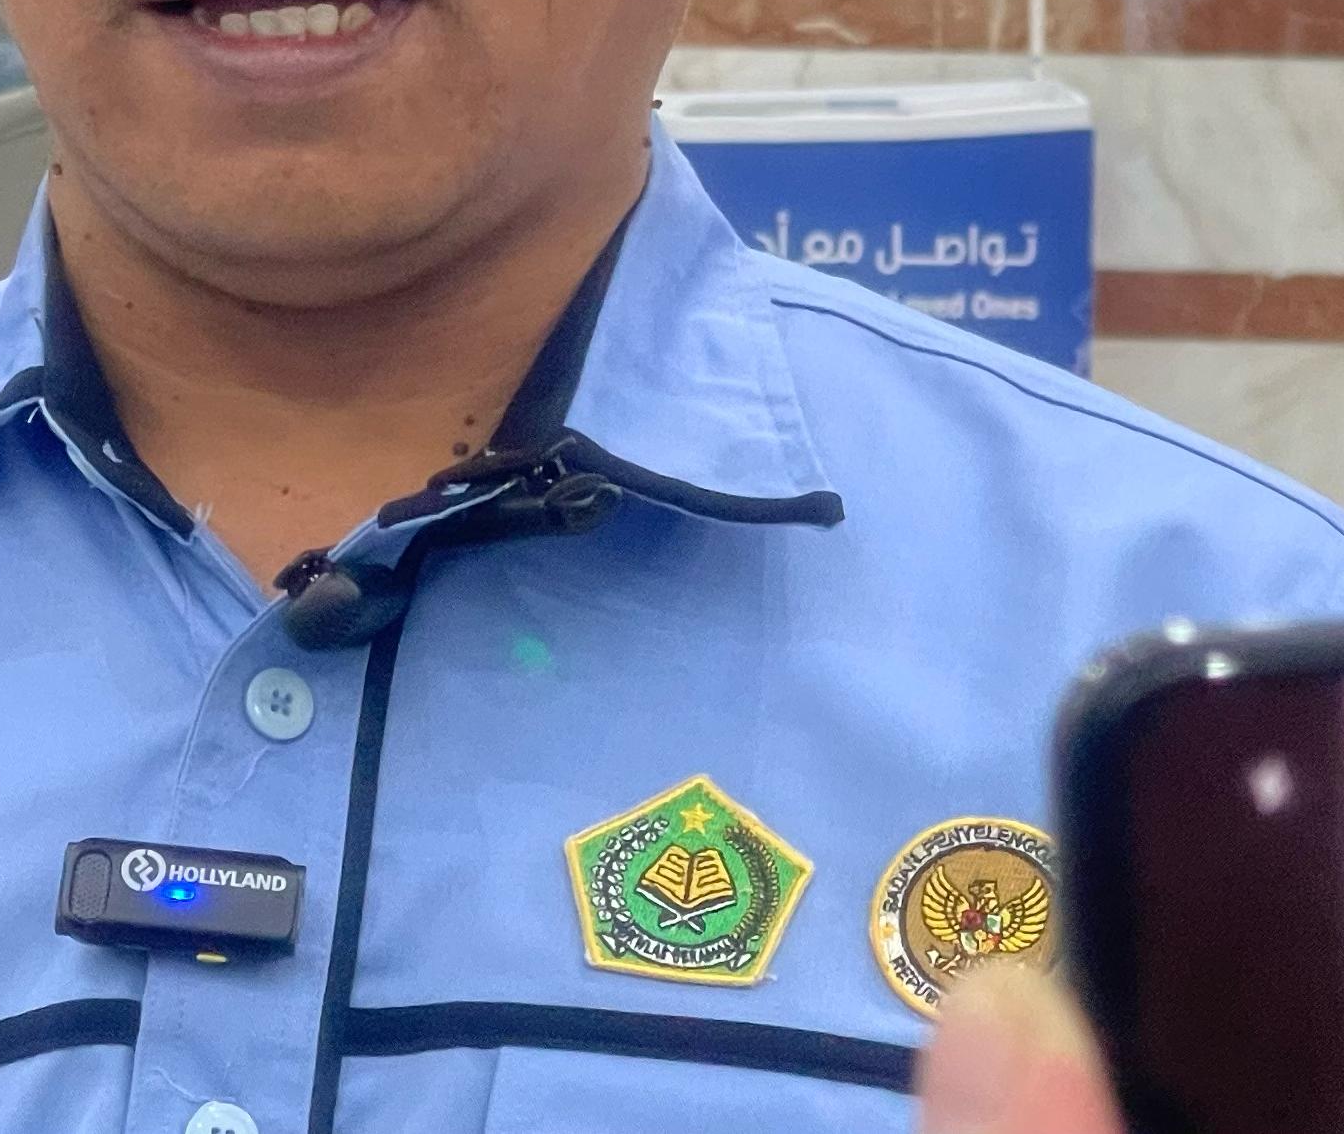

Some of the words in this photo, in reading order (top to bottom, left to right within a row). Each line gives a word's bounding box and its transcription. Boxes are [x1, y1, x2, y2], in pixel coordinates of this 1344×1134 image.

[874, 220, 1040, 277] تواصل
[888, 290, 966, 319] oved
[169, 864, 287, 892] HOLLYLAND
[889, 954, 941, 1005] REPUB
